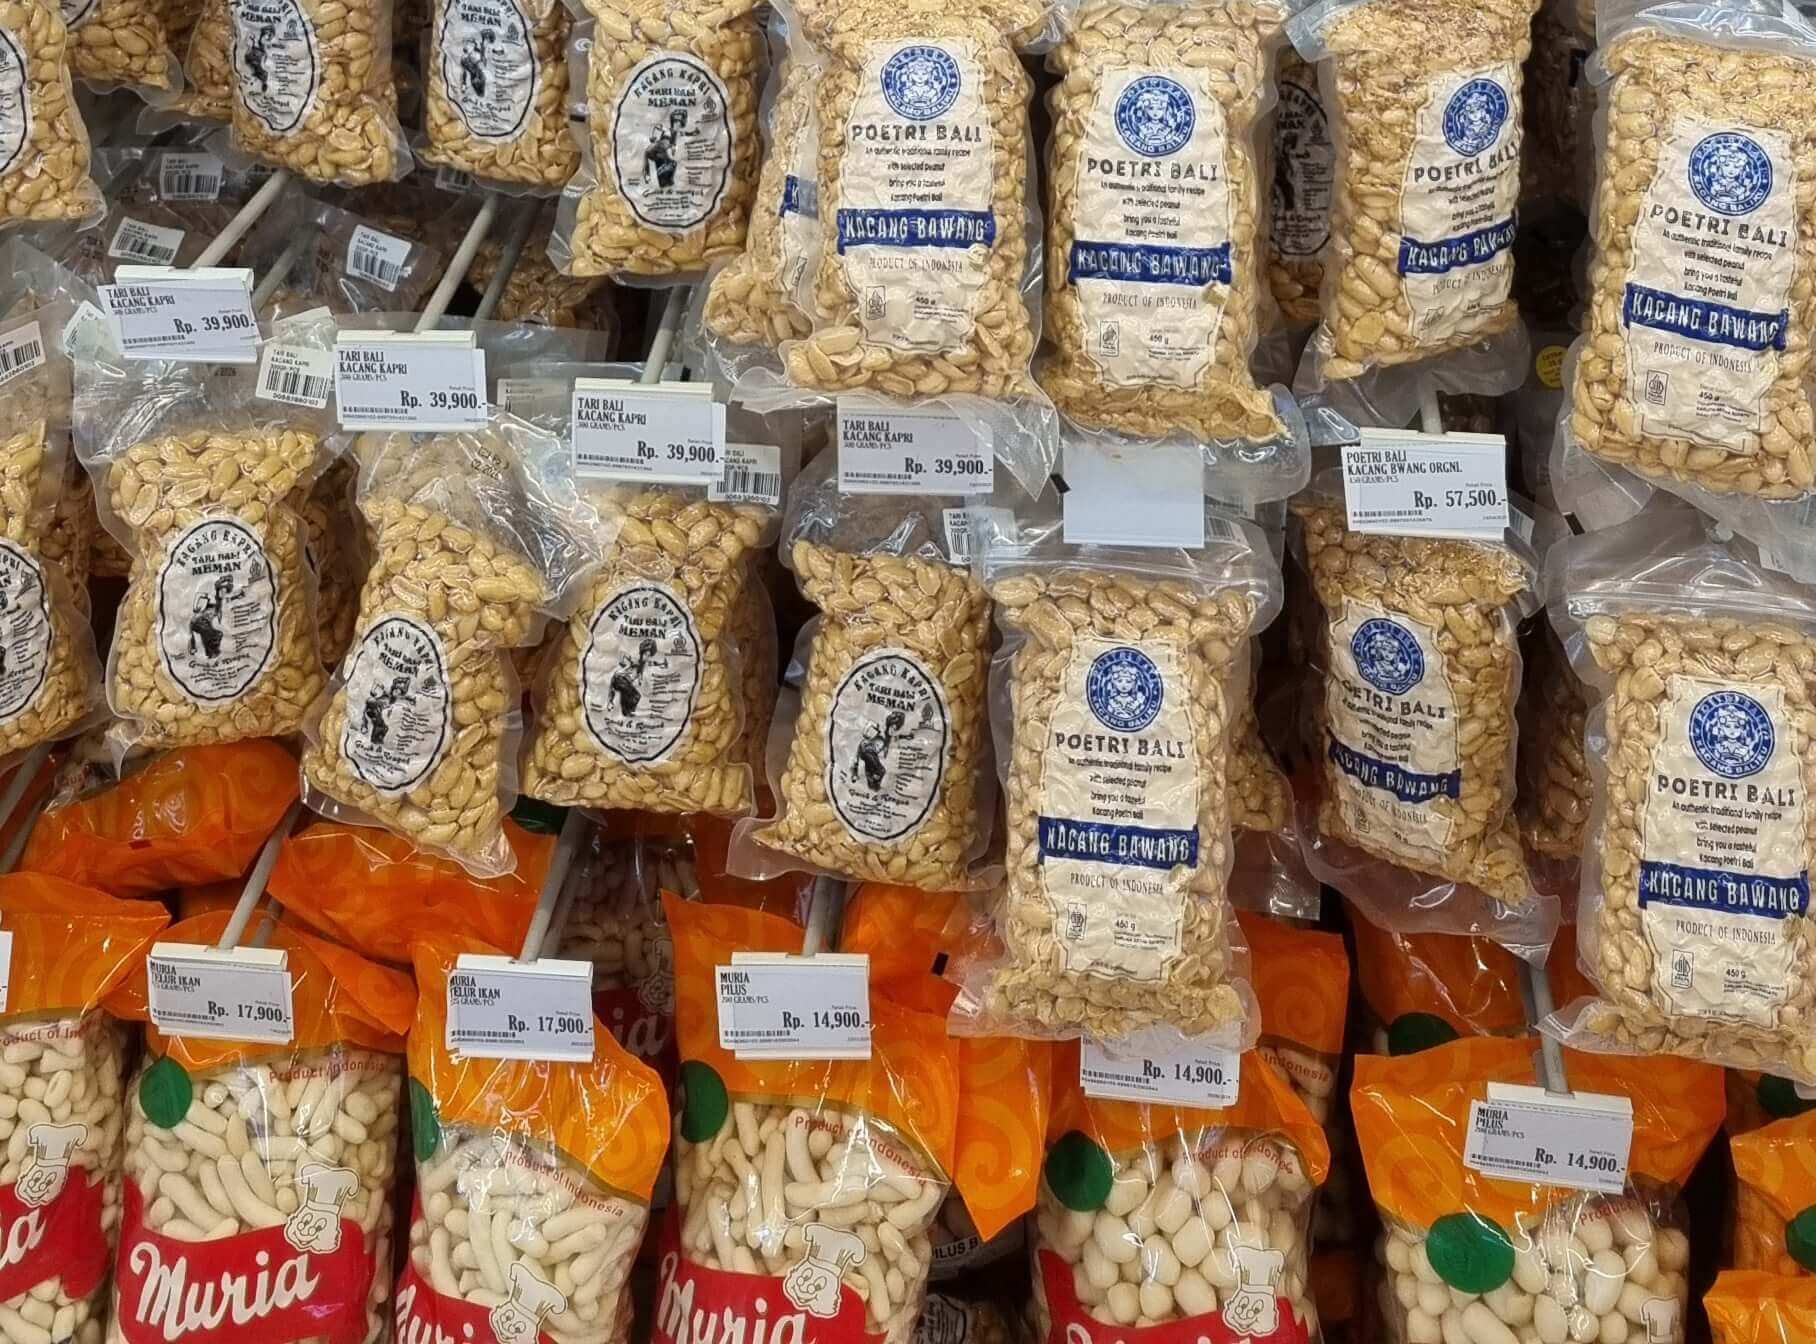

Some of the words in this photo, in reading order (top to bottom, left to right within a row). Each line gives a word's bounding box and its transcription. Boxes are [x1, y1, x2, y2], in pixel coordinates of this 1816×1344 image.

[851, 123, 927, 143] POETRI
[936, 124, 982, 143] BALI
[845, 214, 908, 240] KACANG
[917, 215, 985, 240] BAWANG
[339, 351, 360, 362] TARI
[363, 351, 384, 362] BALI
[339, 362, 376, 374] KACANG
[378, 363, 407, 375] KAPRI
[400, 390, 422, 409] Rp.
[1346, 451, 1383, 463] POETRI
[1385, 450, 1407, 462] BALI
[1347, 464, 1388, 476] KACANG
[1390, 462, 1426, 475] BWANG
[1429, 461, 1462, 473] ORGNL
[1414, 491, 1437, 511] Rp.
[1445, 490, 1506, 509] 57,500.-
[1657, 774, 1738, 800] POETRI
[1746, 782, 1796, 807] BALI
[1649, 870, 1717, 900] KACANG
[1727, 883, 1800, 910] BAWANG
[1676, 919, 1713, 937] PRODUCT
[1718, 925, 1728, 938] OF
[1732, 927, 1777, 945] INDONESIA
[720, 972, 749, 984] MURIA
[478, 987, 500, 999] IKAN
[720, 984, 747, 995] PILUS
[508, 1014, 530, 1032] Rp.
[782, 1011, 805, 1030] Rp.
[505, 1151, 548, 1176] Product
[563, 1179, 624, 1218] Indonesia
[130, 1240, 320, 1342] Muria
